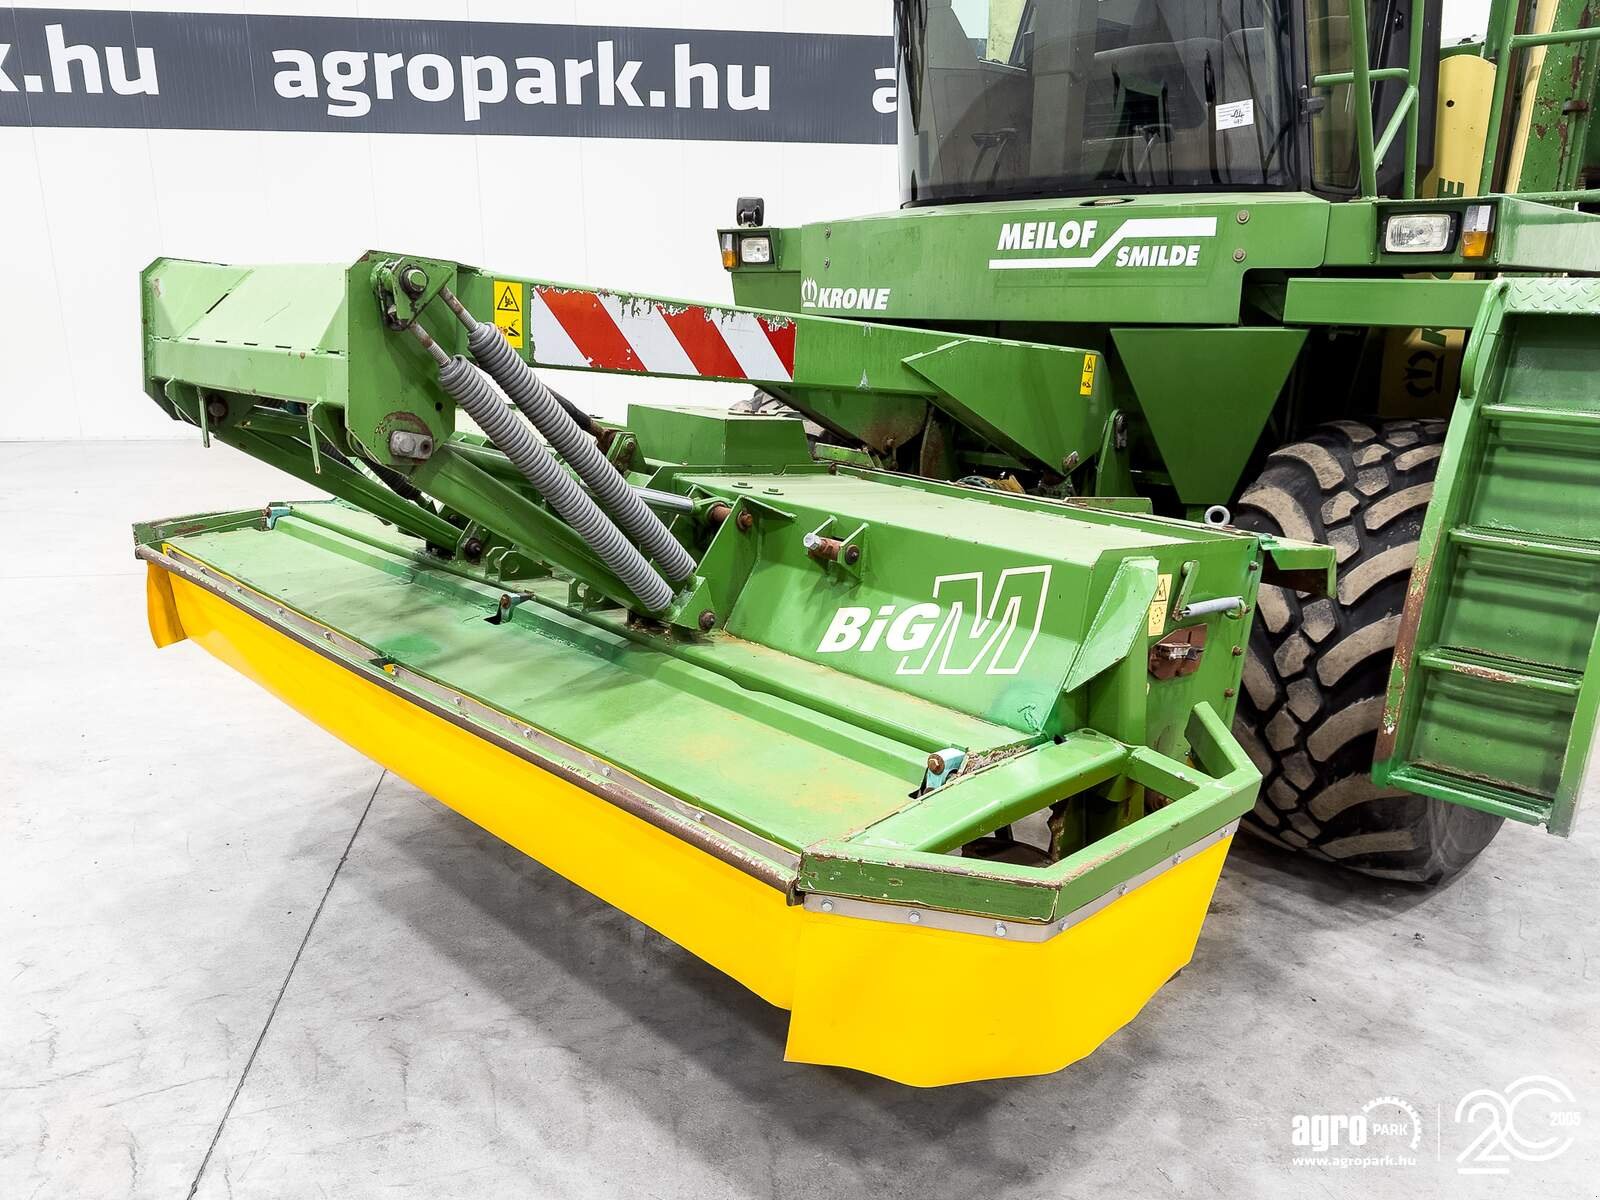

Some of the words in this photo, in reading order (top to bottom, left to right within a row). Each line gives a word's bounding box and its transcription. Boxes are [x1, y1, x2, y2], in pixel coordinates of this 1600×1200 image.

[273, 41, 771, 121] agropark.hu
[997, 220, 1098, 250] MEILOF
[1115, 244, 1200, 268] SMILDE
[818, 287, 891, 311] KRONE
